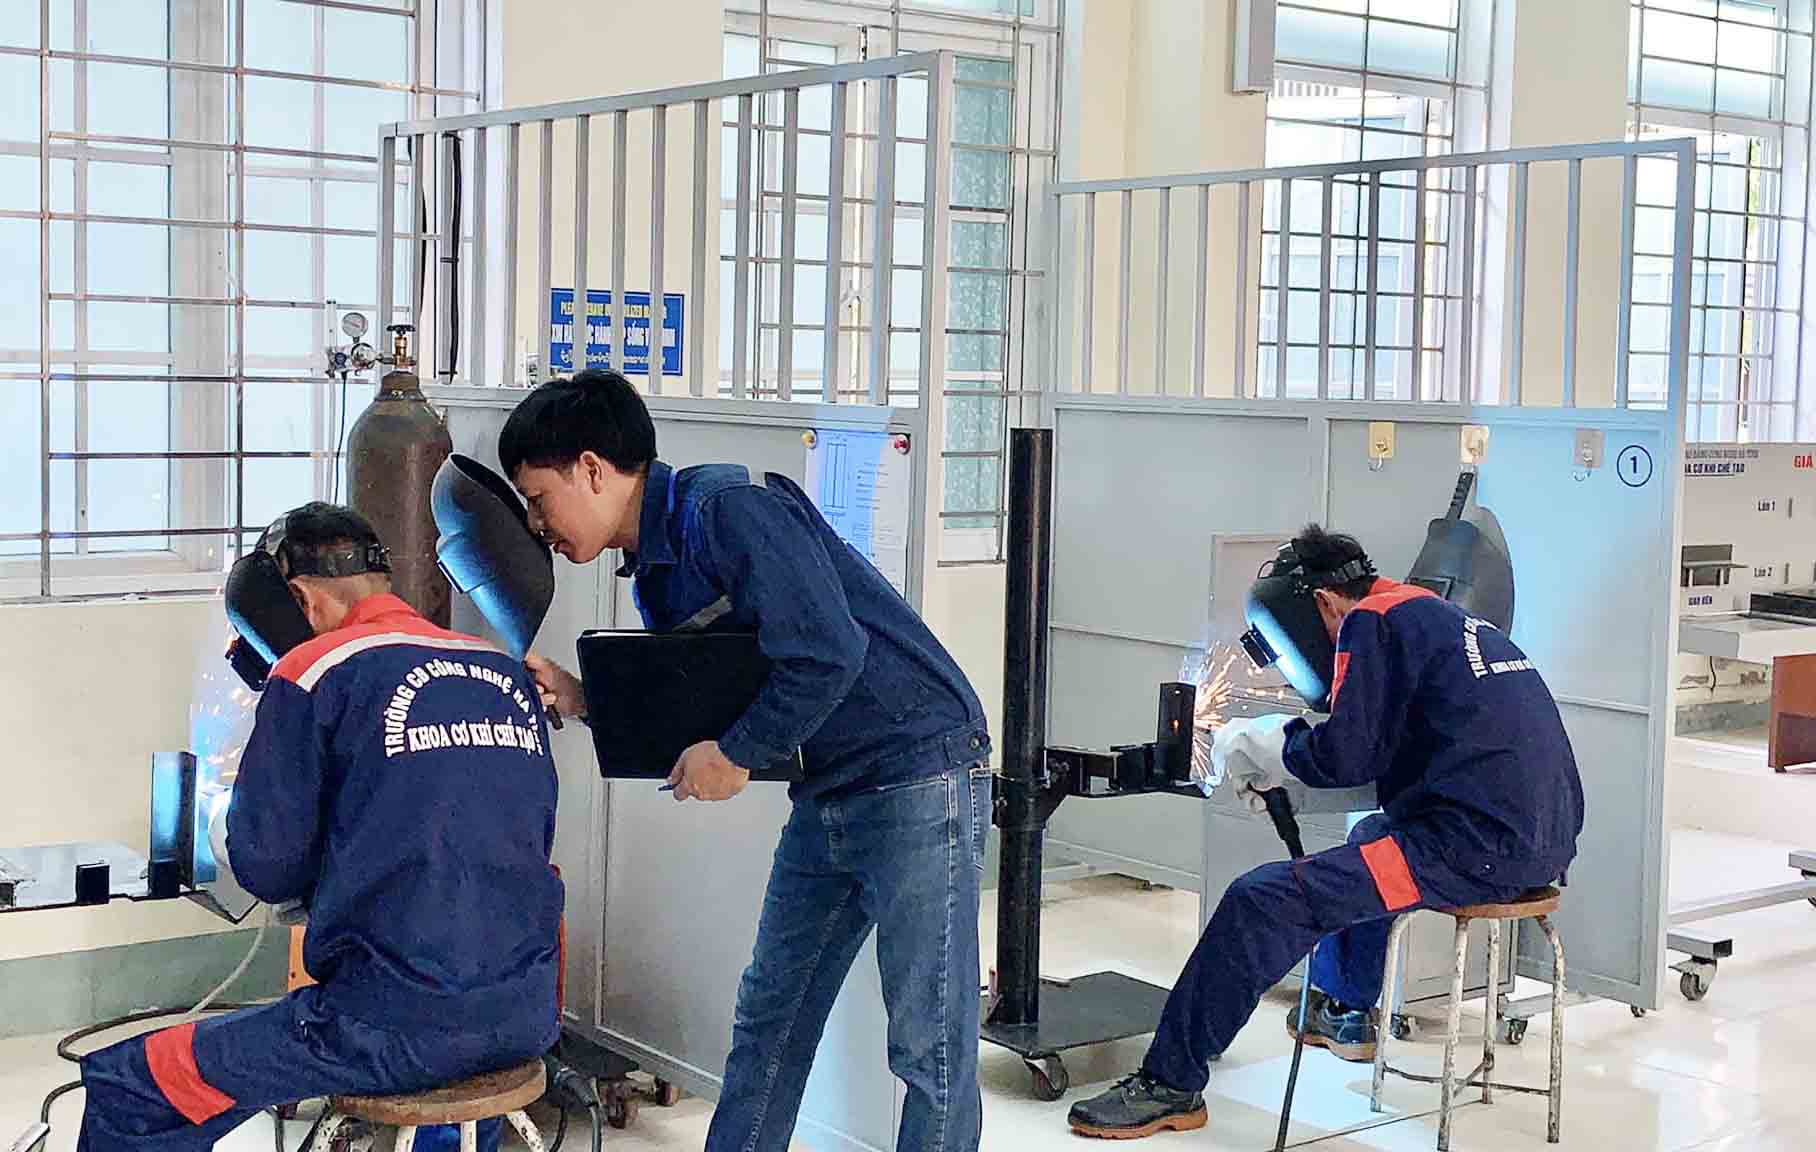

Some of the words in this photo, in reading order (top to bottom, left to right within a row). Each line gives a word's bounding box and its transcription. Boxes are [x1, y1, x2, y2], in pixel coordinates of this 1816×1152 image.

[1630, 455, 1637, 474] 1
[383, 684, 417, 758] TRƯỜNG
[425, 658, 468, 678] CÔNG
[407, 724, 452, 752] KHOA
[451, 719, 470, 746] CƠ
[468, 718, 495, 746] KHÍ
